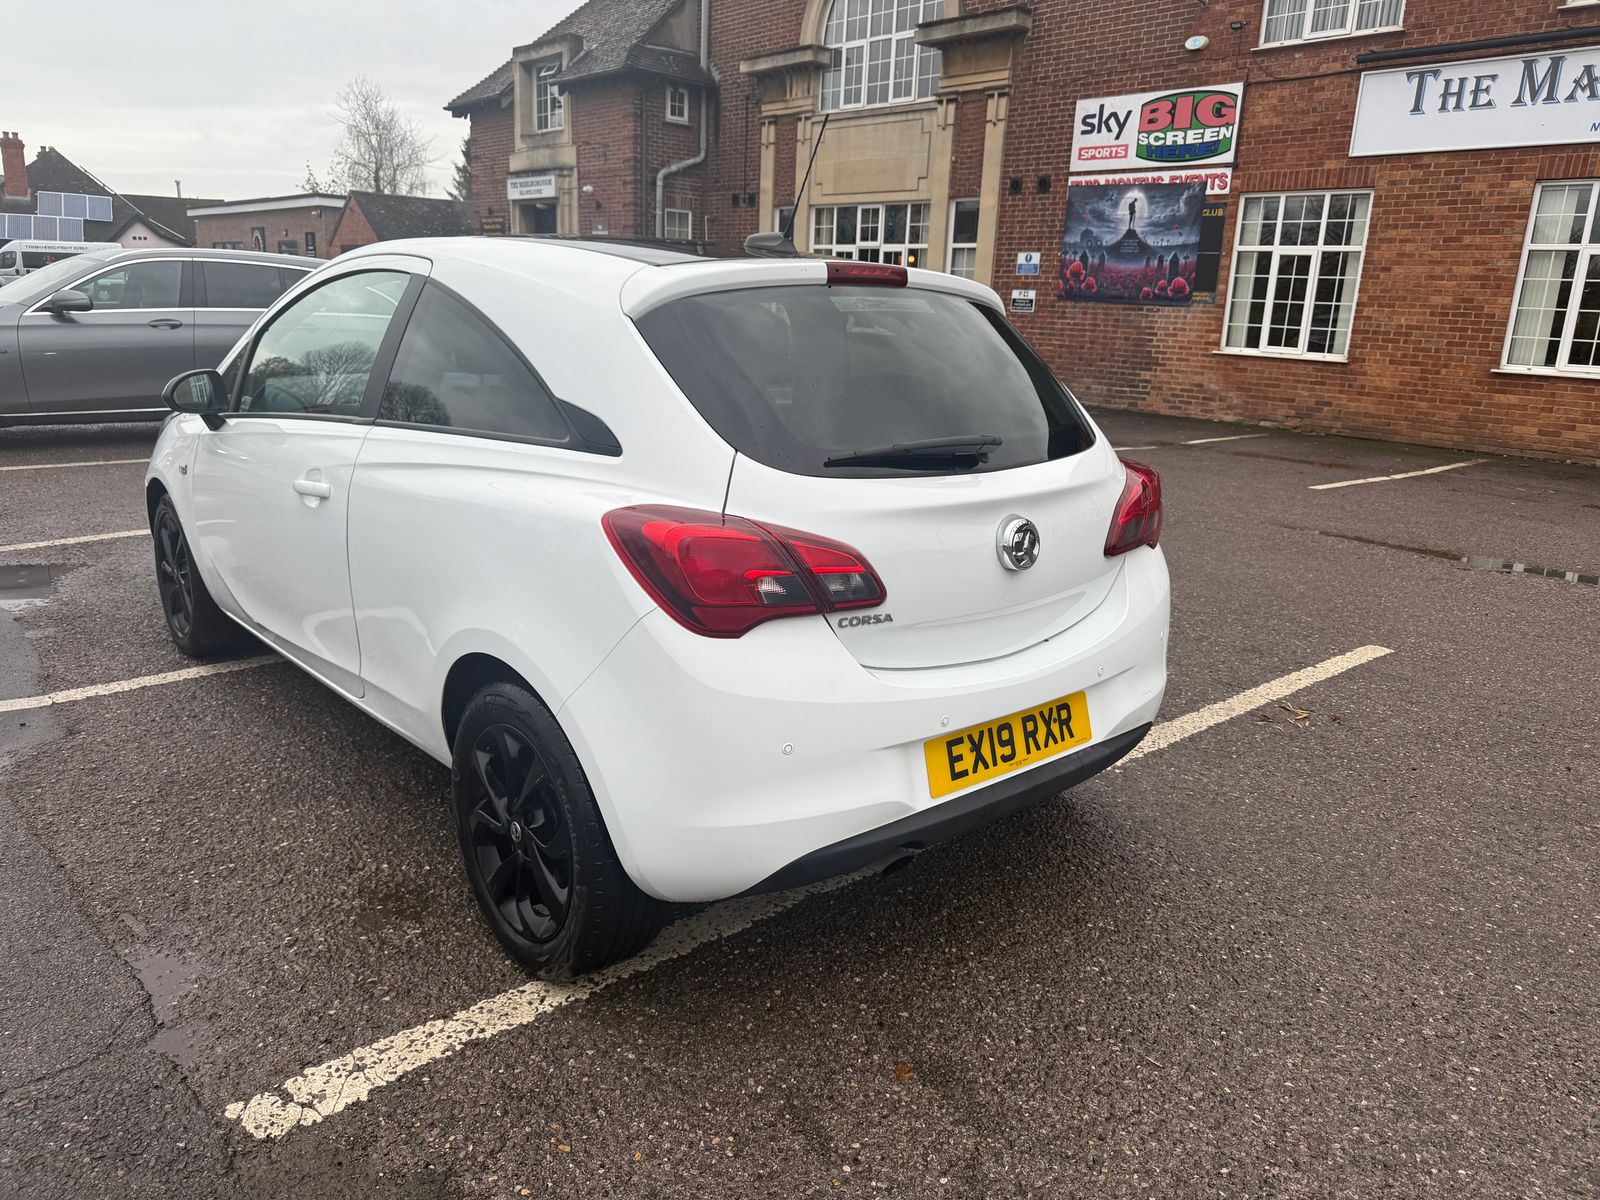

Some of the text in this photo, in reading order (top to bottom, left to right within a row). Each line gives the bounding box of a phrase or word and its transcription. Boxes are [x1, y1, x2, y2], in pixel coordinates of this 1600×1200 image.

[1405, 69, 1499, 115] THE
[1080, 103, 1133, 141] sky
[1138, 94, 1236, 132] BIG
[1138, 126, 1233, 146] SCREEN
[1146, 140, 1221, 158] HERE!
[1080, 146, 1126, 160] SPORTS
[838, 613, 893, 628] CORSA
[946, 702, 1075, 781] EX19 RXR
